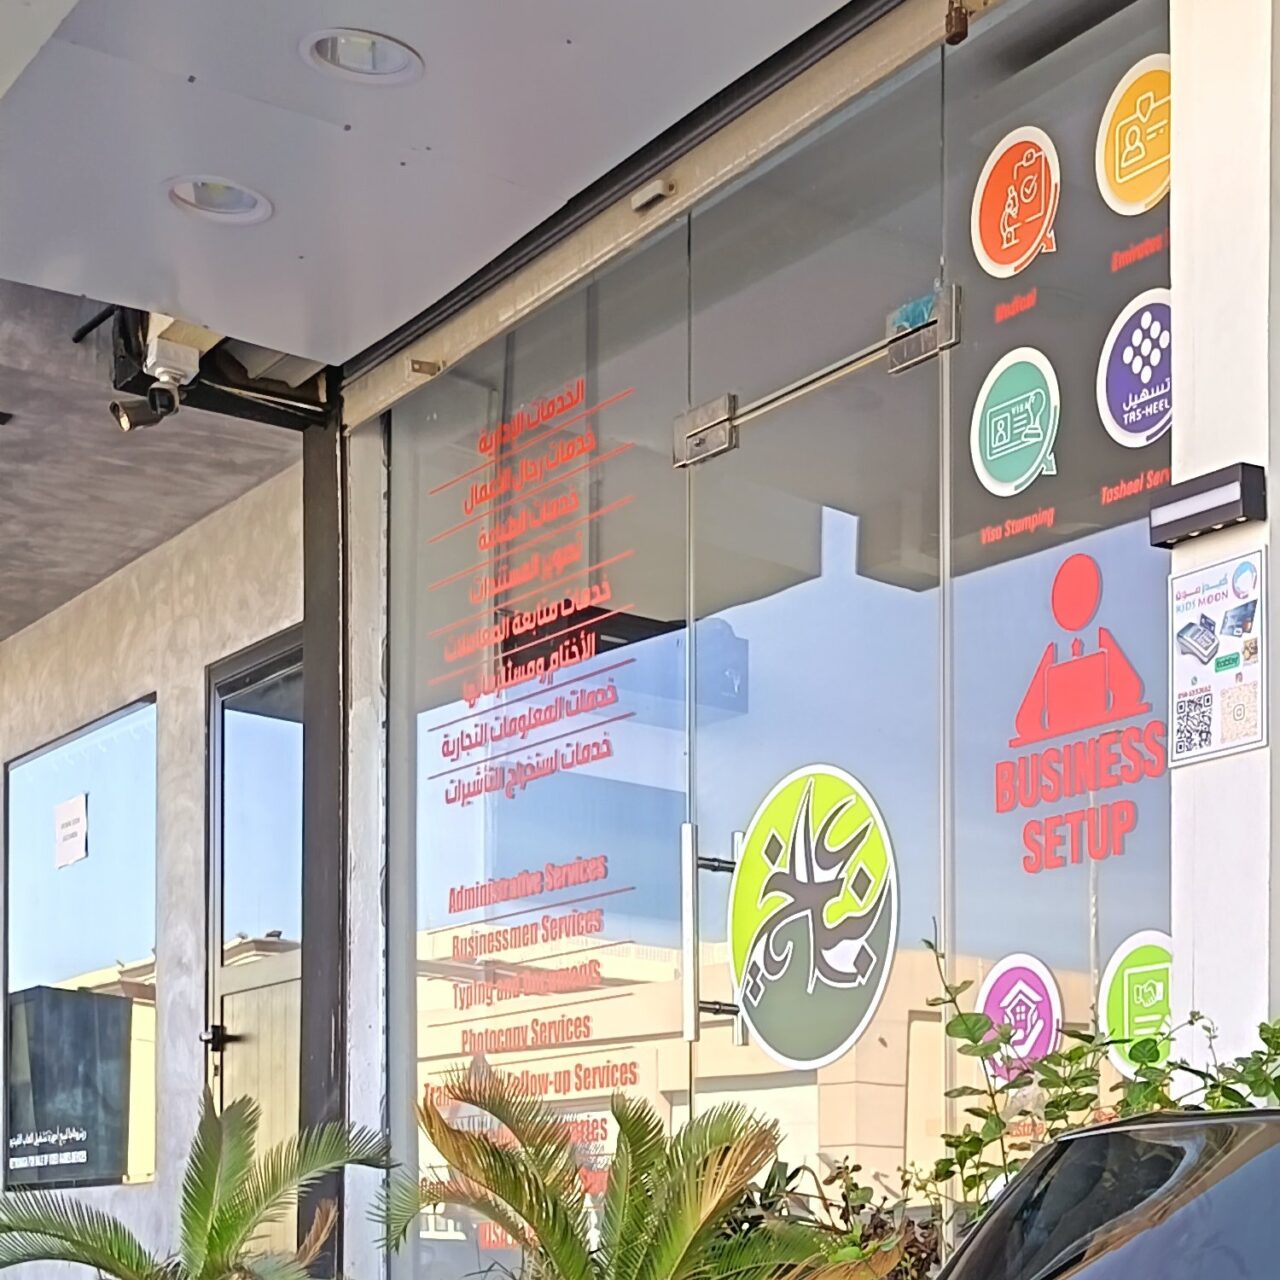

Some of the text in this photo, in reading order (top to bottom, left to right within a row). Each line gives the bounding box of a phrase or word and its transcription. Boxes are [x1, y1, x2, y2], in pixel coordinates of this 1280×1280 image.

[1122, 377, 1171, 412] تسهيل
[1122, 397, 1171, 426] TAS-HEEL
[1197, 590, 1230, 609] MOON
[441, 676, 620, 763] خدمات المعلومات التجارية
[560, 731, 614, 770] خدمات
[994, 719, 1168, 814] BUSINESS
[1023, 799, 1138, 875] SETUP
[448, 854, 609, 915] Administrative Services
[541, 908, 605, 945] Services
[530, 1013, 592, 1047] Services
[574, 1059, 640, 1092] Services
